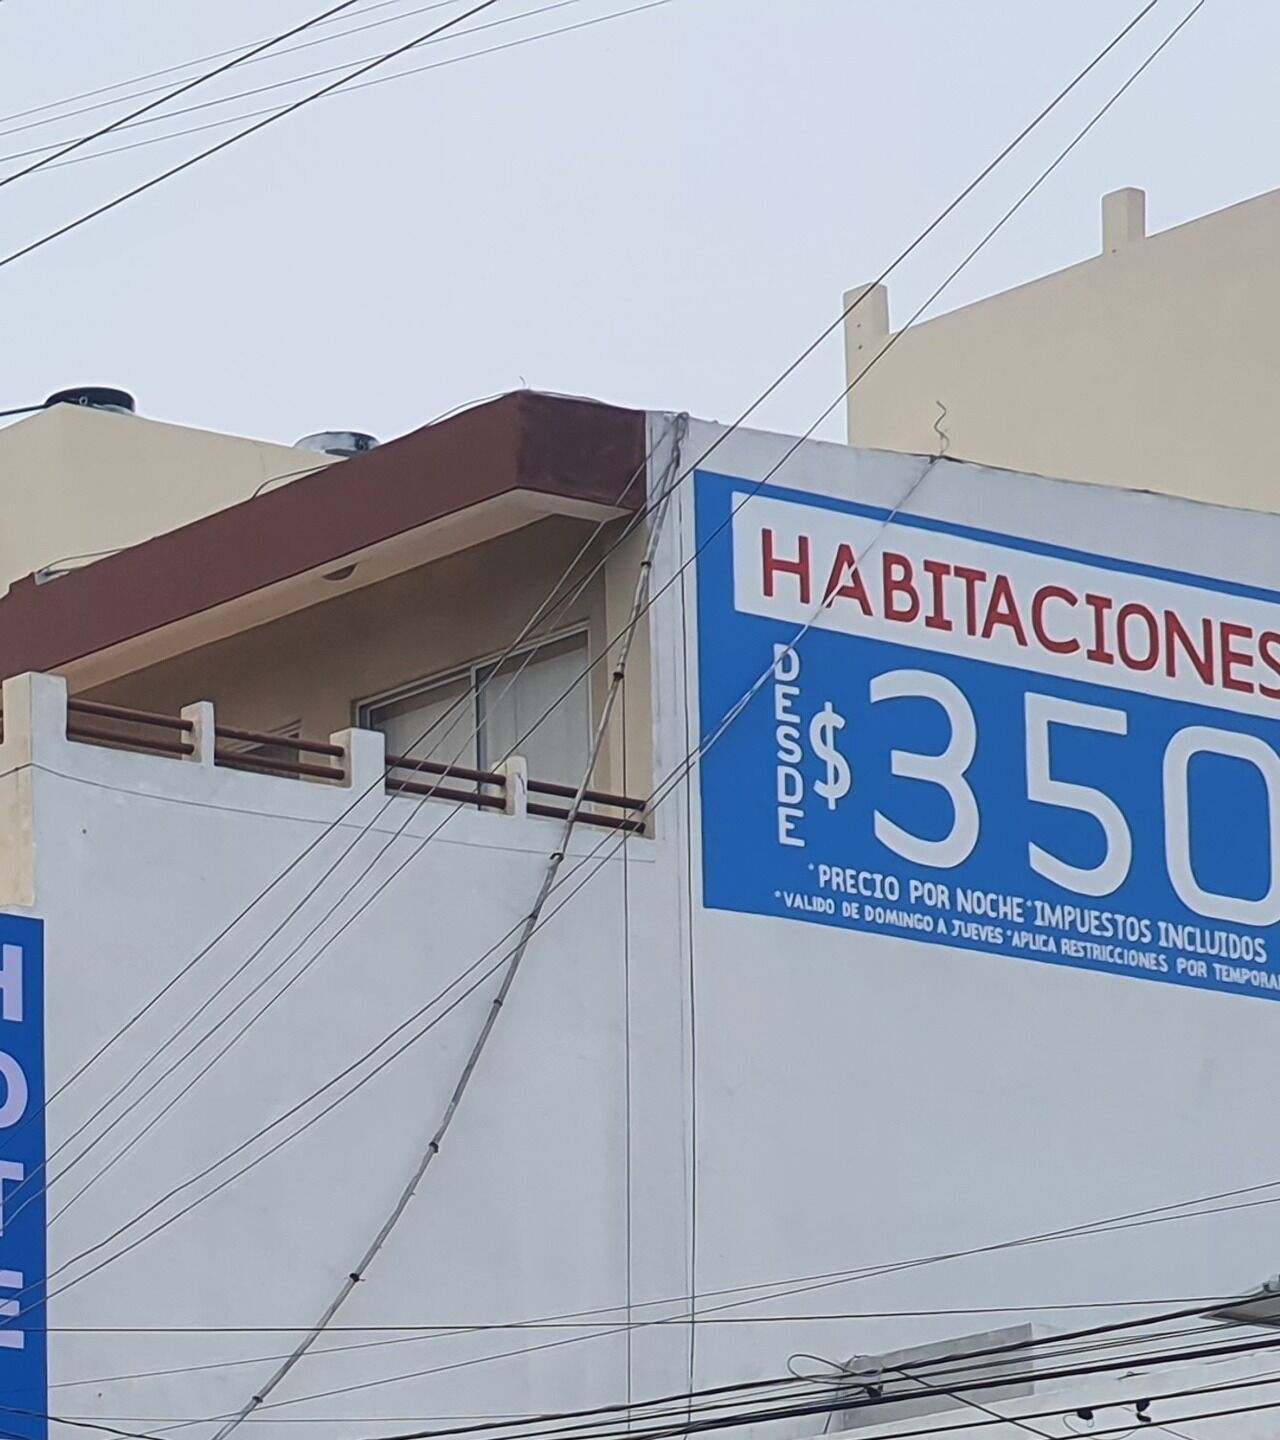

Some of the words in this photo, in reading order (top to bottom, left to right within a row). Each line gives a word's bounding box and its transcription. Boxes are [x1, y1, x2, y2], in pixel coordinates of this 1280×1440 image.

[773, 642, 806, 848] DESDE
[842, 901, 860, 919] DE
[864, 904, 934, 932] DOMINGO
[937, 918, 947, 935] A
[951, 918, 1004, 944] JUEVES
[1061, 938, 1169, 973] RESTRICCIONES
[1176, 956, 1208, 979] POR
[909, 879, 950, 910] POR
[956, 886, 1025, 924] NOCHE
[1157, 920, 1268, 964] INCLUIDOS
